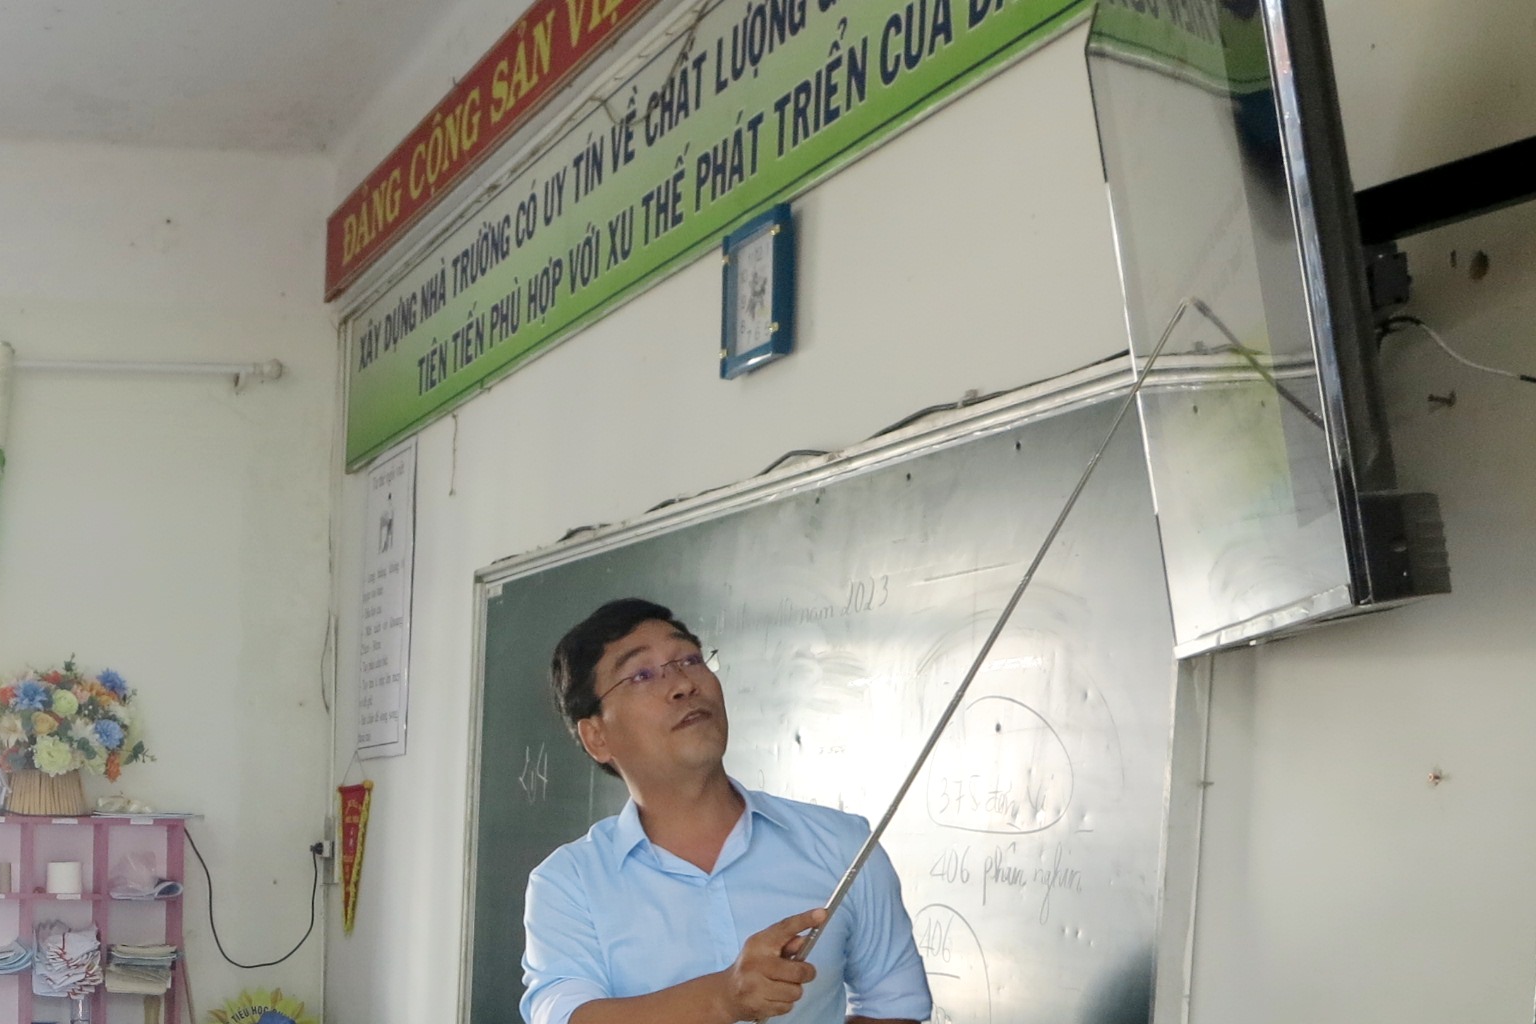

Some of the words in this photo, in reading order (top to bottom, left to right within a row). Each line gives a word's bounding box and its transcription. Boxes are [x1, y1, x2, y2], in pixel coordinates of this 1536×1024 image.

[342, 167, 402, 267] ĐẢNG
[409, 87, 481, 200] CỘNG
[490, 10, 556, 125] SẢN
[417, 337, 448, 396] TIÊN
[452, 301, 485, 373] TIẾN
[489, 276, 521, 349] PHÙ
[527, 256, 563, 327] HỢP
[569, 221, 601, 294] VỚI
[606, 204, 634, 271] XU
[641, 142, 690, 246] THẾ
[694, 109, 764, 213] PHÁT
[774, 17, 867, 158] TRIỂN
[420, 257, 447, 324] NHÀ
[451, 214, 511, 298] TRƯỜNG
[515, 179, 538, 248] CÓ
[543, 166, 567, 227] UY
[572, 132, 604, 203] TÍN
[611, 86, 638, 174] VỀ
[929, 845, 972, 884] 406
